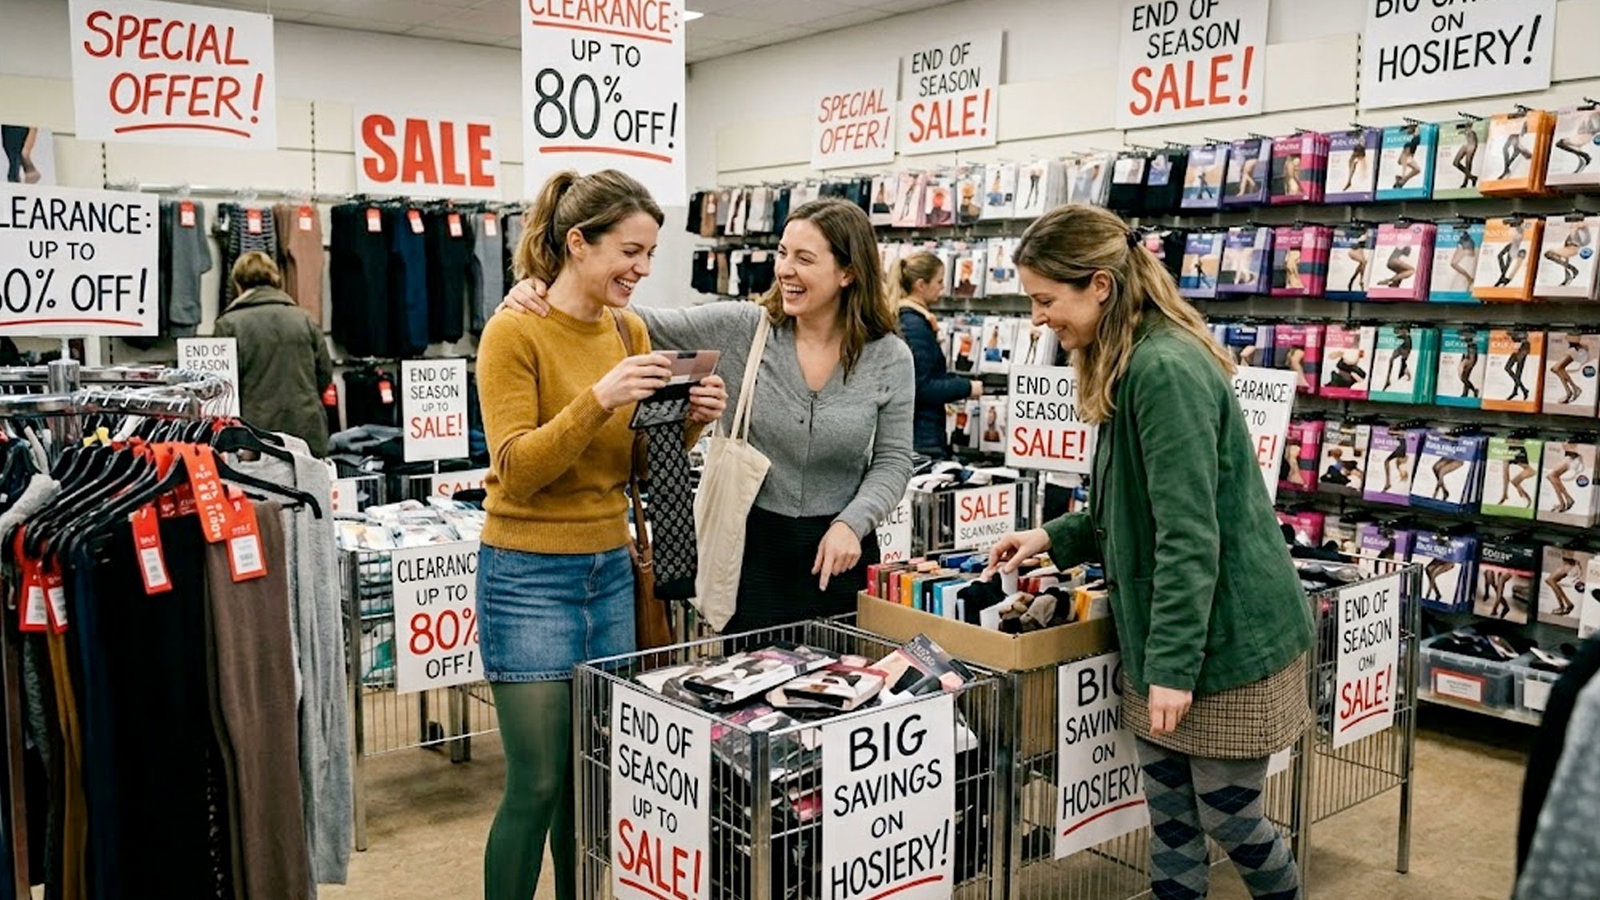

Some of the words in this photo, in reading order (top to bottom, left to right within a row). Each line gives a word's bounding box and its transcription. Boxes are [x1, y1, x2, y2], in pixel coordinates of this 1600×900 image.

[1132, 0, 1178, 32] END
[1431, 12, 1464, 33] ON
[84, 11, 249, 65] SPECIAL
[571, 38, 600, 61] UP
[610, 44, 641, 67] TO
[1147, 19, 1240, 59] SEASON
[1378, 14, 1542, 82] HOSIERY!
[912, 49, 943, 74] END
[949, 42, 971, 66] OF
[919, 67, 981, 97] SEASON
[1129, 45, 1254, 116] SALE!
[109, 73, 263, 124] OFFER!
[534, 68, 622, 139] 80%
[613, 102, 677, 149] OFF!
[818, 88, 888, 123] SPECIAL
[909, 88, 990, 143] SALE!
[361, 114, 495, 187] SALE
[820, 116, 890, 154] OFFER!
[0, 196, 151, 234] EARANCE:
[29, 241, 58, 259] UP
[66, 243, 95, 260] TO
[0, 268, 56, 313] 0%
[71, 267, 147, 315] OFF!
[185, 345, 209, 357] END
[212, 345, 227, 356] OF
[186, 360, 230, 371] SEASON
[410, 368, 437, 383] END
[439, 367, 457, 381] OF
[410, 385, 459, 400] SEASON
[1016, 375, 1051, 395] END
[421, 402, 436, 412] UP
[436, 402, 449, 411] TO
[1015, 400, 1081, 422] SEASON
[1252, 410, 1267, 426] TO
[410, 414, 463, 440] SALE!
[1012, 426, 1086, 461] SALE!
[960, 490, 1009, 523] SALE
[398, 552, 478, 583] CLEARANC
[416, 588, 440, 606] UP
[445, 584, 468, 602] TO
[1344, 595, 1370, 623] END
[1373, 589, 1389, 614] OF
[1344, 617, 1392, 654] SEASON
[425, 651, 474, 679] OFF!
[1340, 663, 1392, 720] SALE!
[620, 702, 659, 745] END
[666, 723, 693, 759] OF
[1065, 705, 1122, 745] SAVIN
[850, 714, 927, 772] BIG
[1092, 742, 1115, 764] ON
[618, 744, 699, 809] SEASON
[833, 758, 942, 817] SAVINGS
[1062, 763, 1143, 820] HOSIERY
[633, 794, 652, 819] UP
[657, 806, 678, 833] TO
[871, 811, 903, 838] ON
[617, 818, 702, 900] SALE!
[831, 818, 949, 900] HOSIERY!
